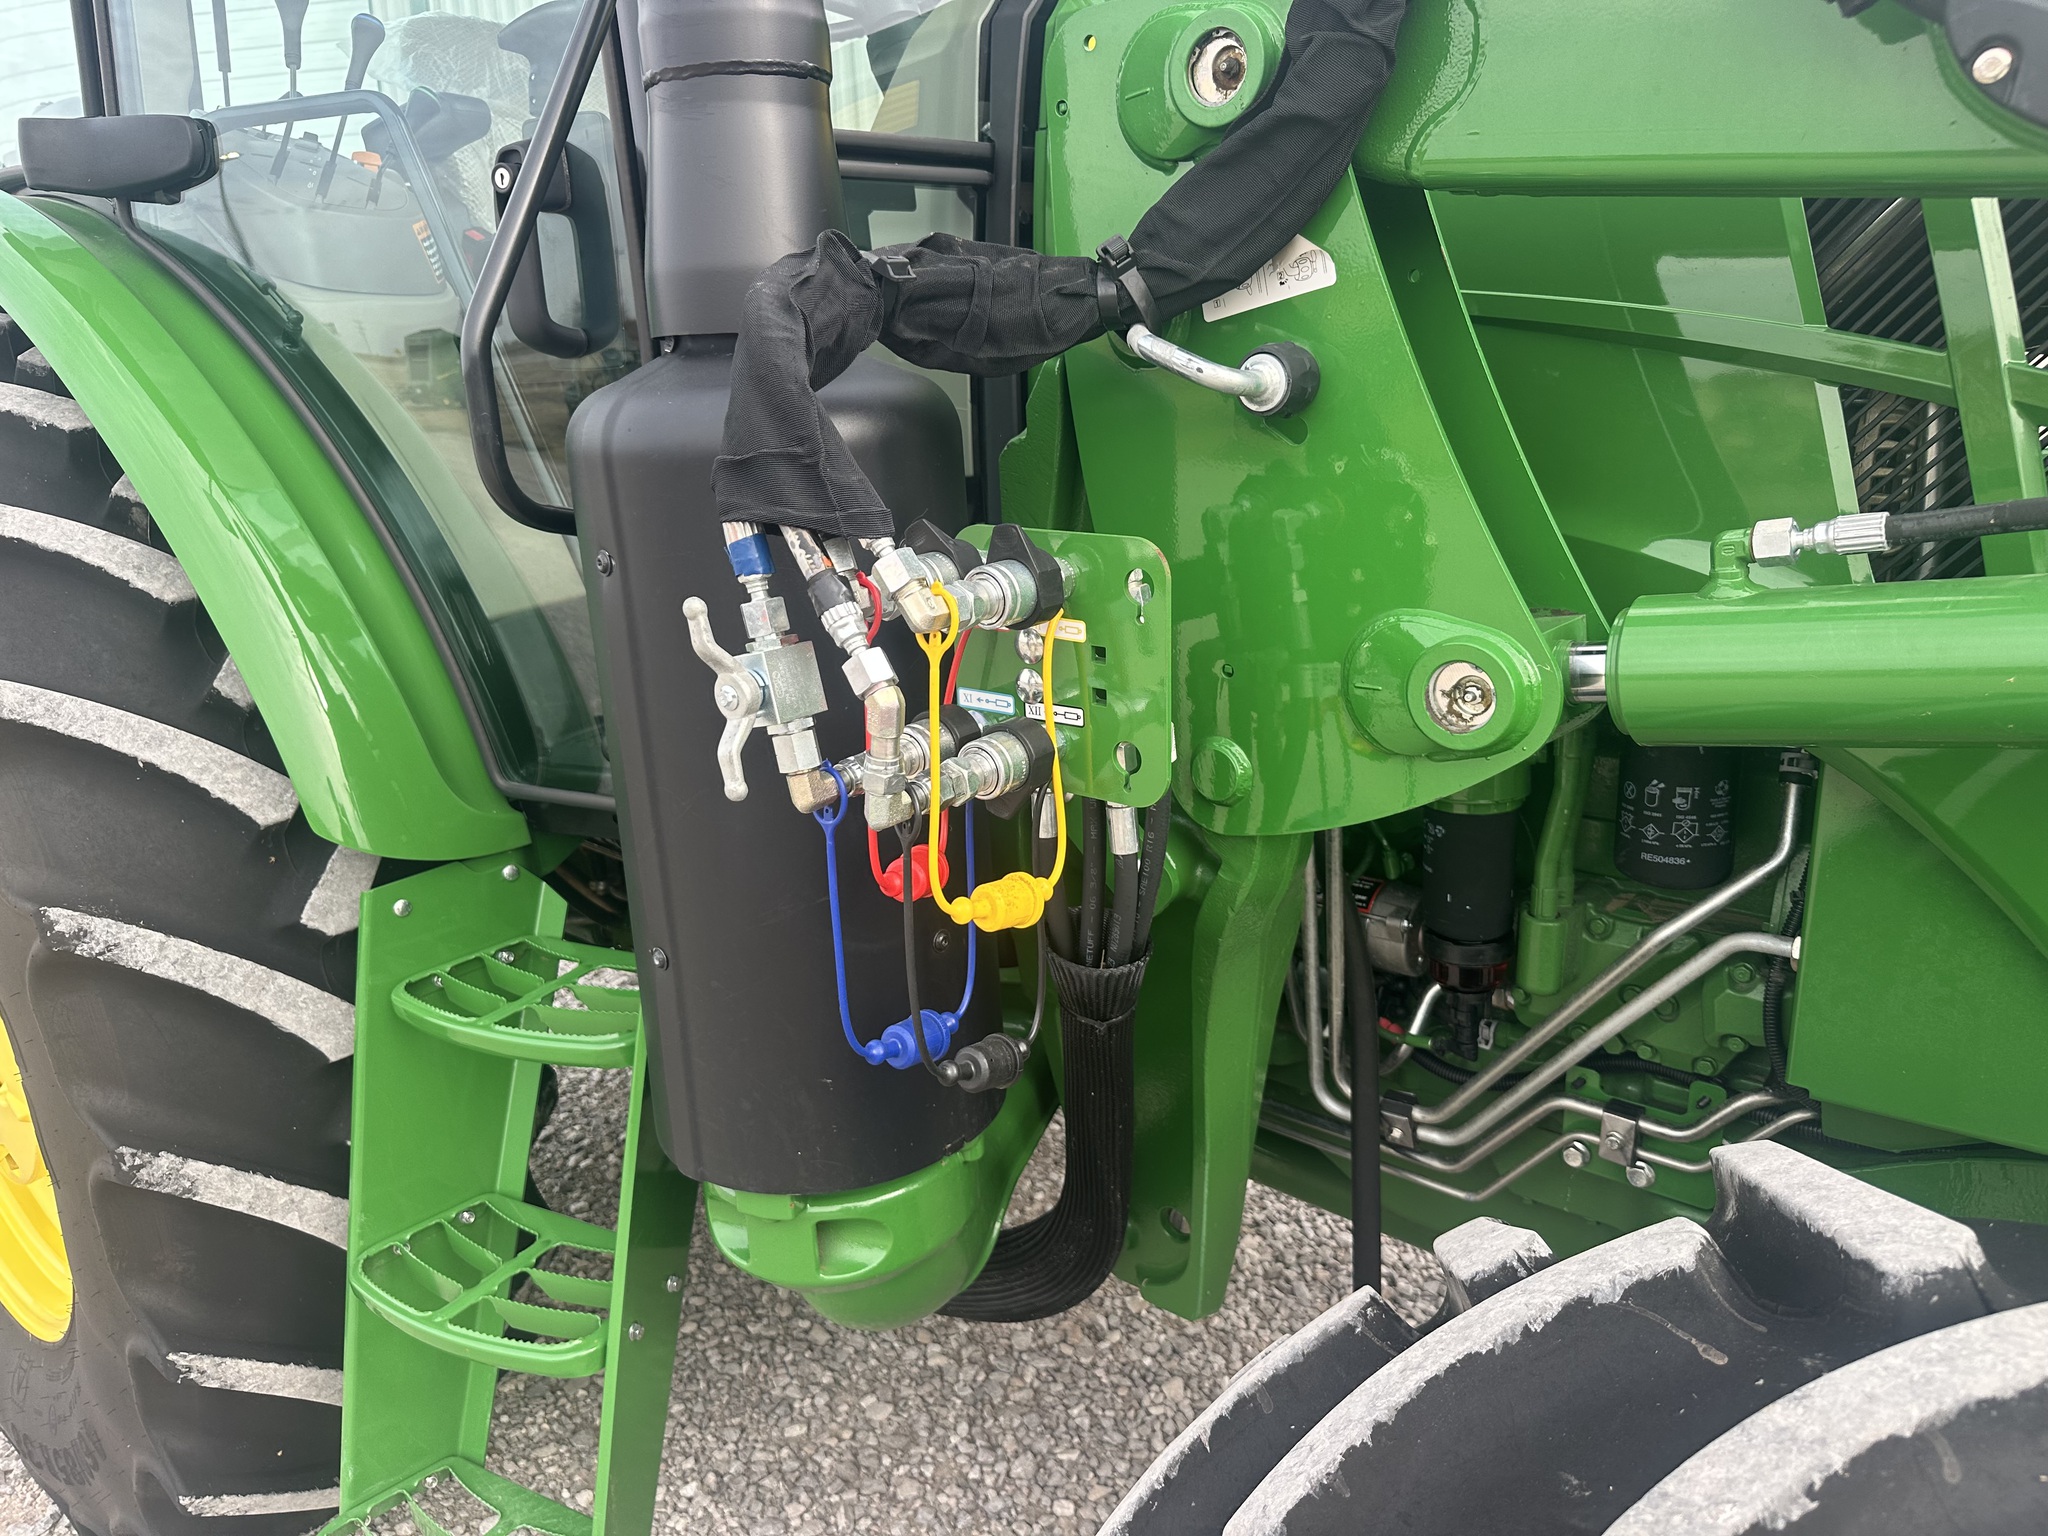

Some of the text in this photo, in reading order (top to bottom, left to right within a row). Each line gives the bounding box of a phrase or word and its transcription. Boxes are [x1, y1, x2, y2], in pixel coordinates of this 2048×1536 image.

[963, 692, 973, 703] XI
[1027, 705, 1042, 717] XII
[1139, 858, 1151, 895] SAE100
[1146, 831, 1155, 853] R16
